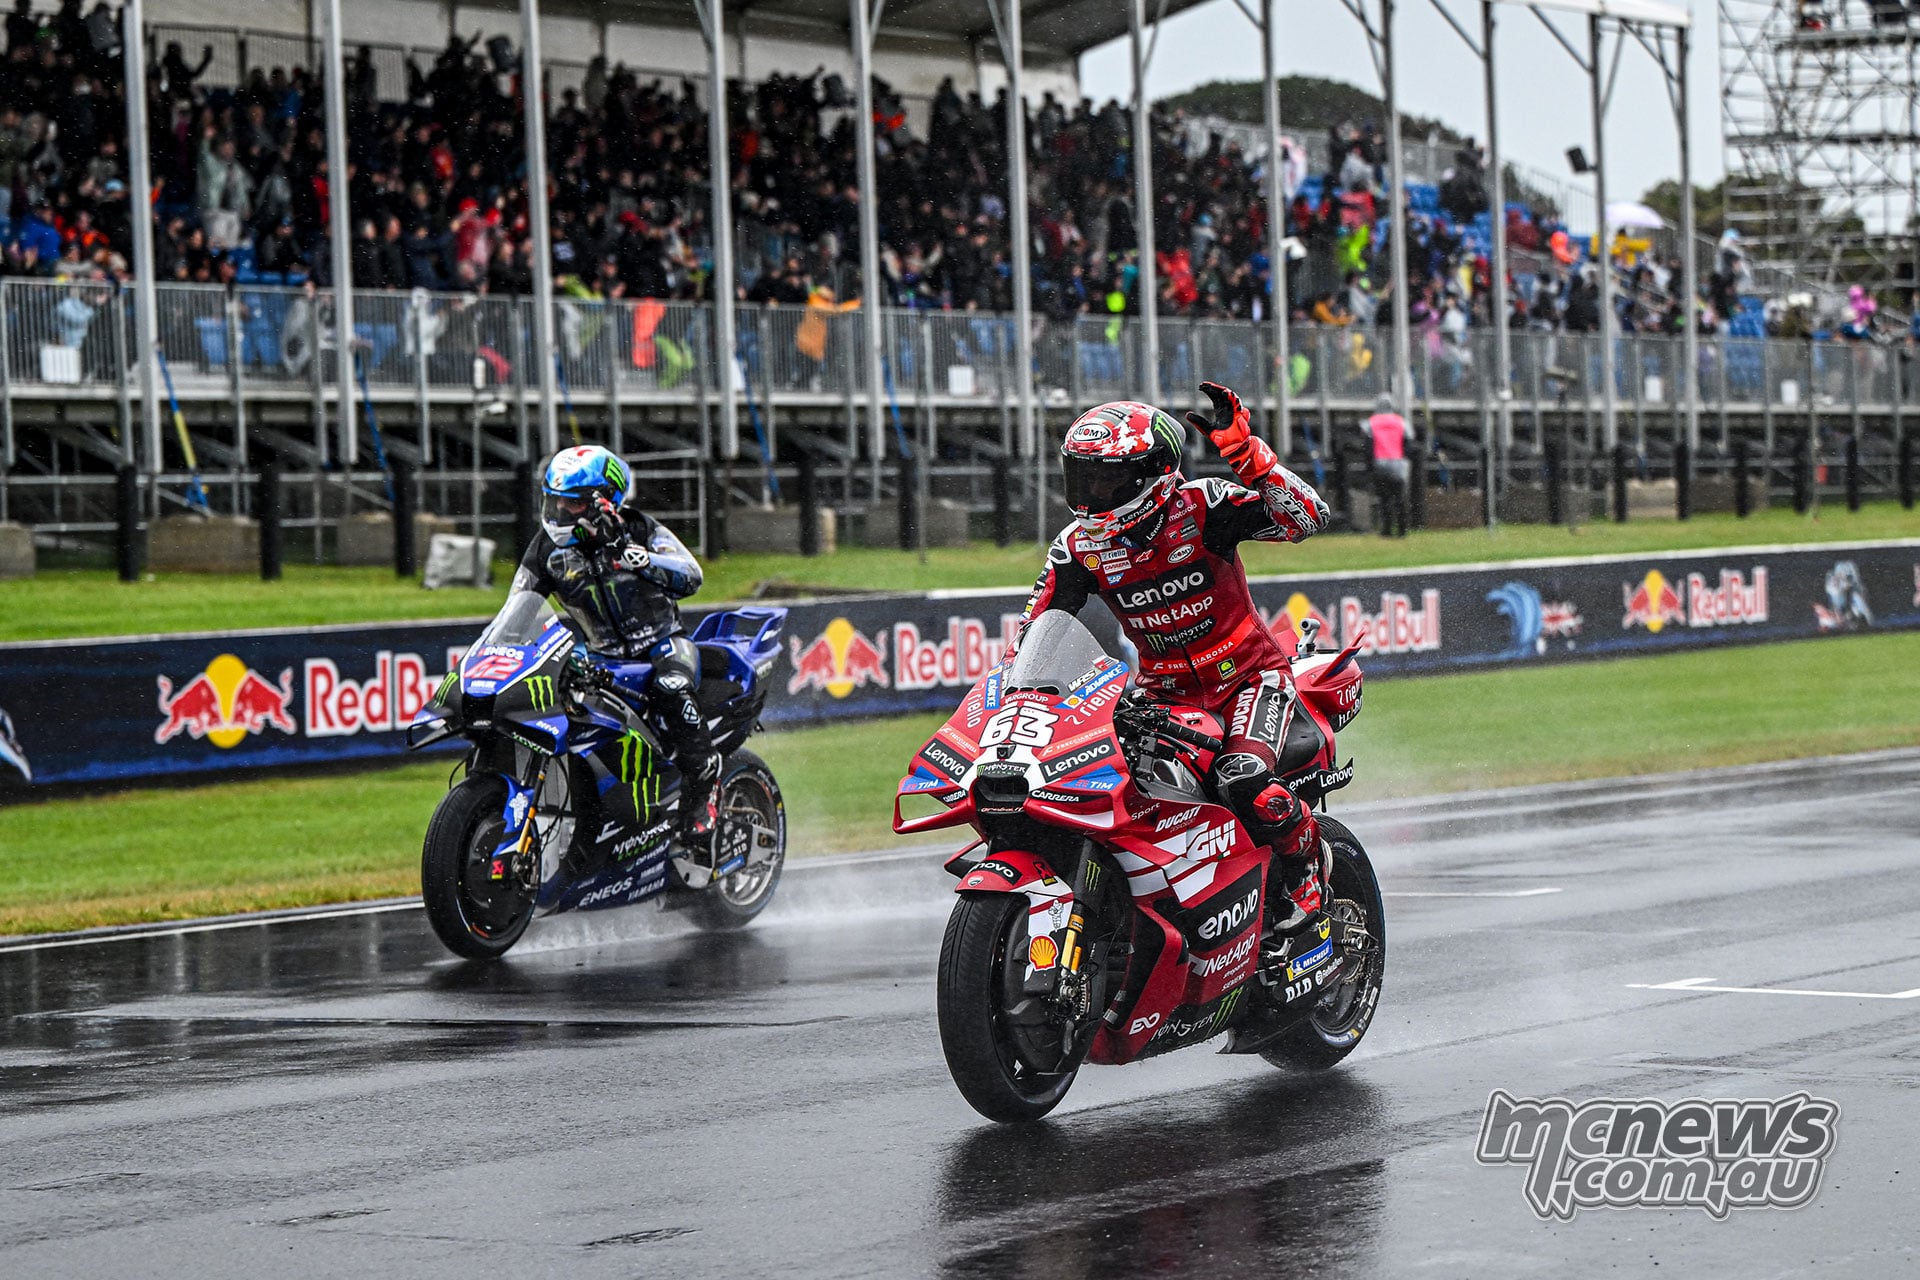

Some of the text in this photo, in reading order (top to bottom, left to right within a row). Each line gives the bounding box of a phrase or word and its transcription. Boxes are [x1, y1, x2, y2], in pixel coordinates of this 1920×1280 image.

[1074, 428, 1107, 440] SUOMY
[1121, 499, 1154, 523] Lenovo
[1168, 503, 1198, 522] motorola
[1145, 514, 1164, 541] Lenovo
[1117, 571, 1205, 609] Lenovo
[1146, 596, 1214, 628] NetApp
[484, 646, 525, 661] ENEOS
[1084, 664, 1123, 696] ADVANCE
[1080, 683, 1124, 717] riello
[1229, 687, 1256, 738] DUCATI
[978, 705, 1060, 749] 63
[1258, 693, 1281, 743] Lenovo
[924, 742, 966, 776] Lenovo
[984, 763, 1026, 773] MONSTER
[1044, 744, 1111, 777] Lenovo
[918, 779, 939, 790] TIM
[1090, 781, 1114, 790] TIM
[1319, 766, 1354, 788] Lenovo
[1031, 790, 1080, 803] CARRERA
[1131, 802, 1161, 821] Sport
[1155, 805, 1203, 833] DUCATI
[1186, 819, 1236, 861] GIVI
[973, 861, 1015, 878] novo
[578, 877, 634, 907] ENEOS
[1198, 888, 1258, 940] enovo
[1203, 933, 1256, 977] NetApp
